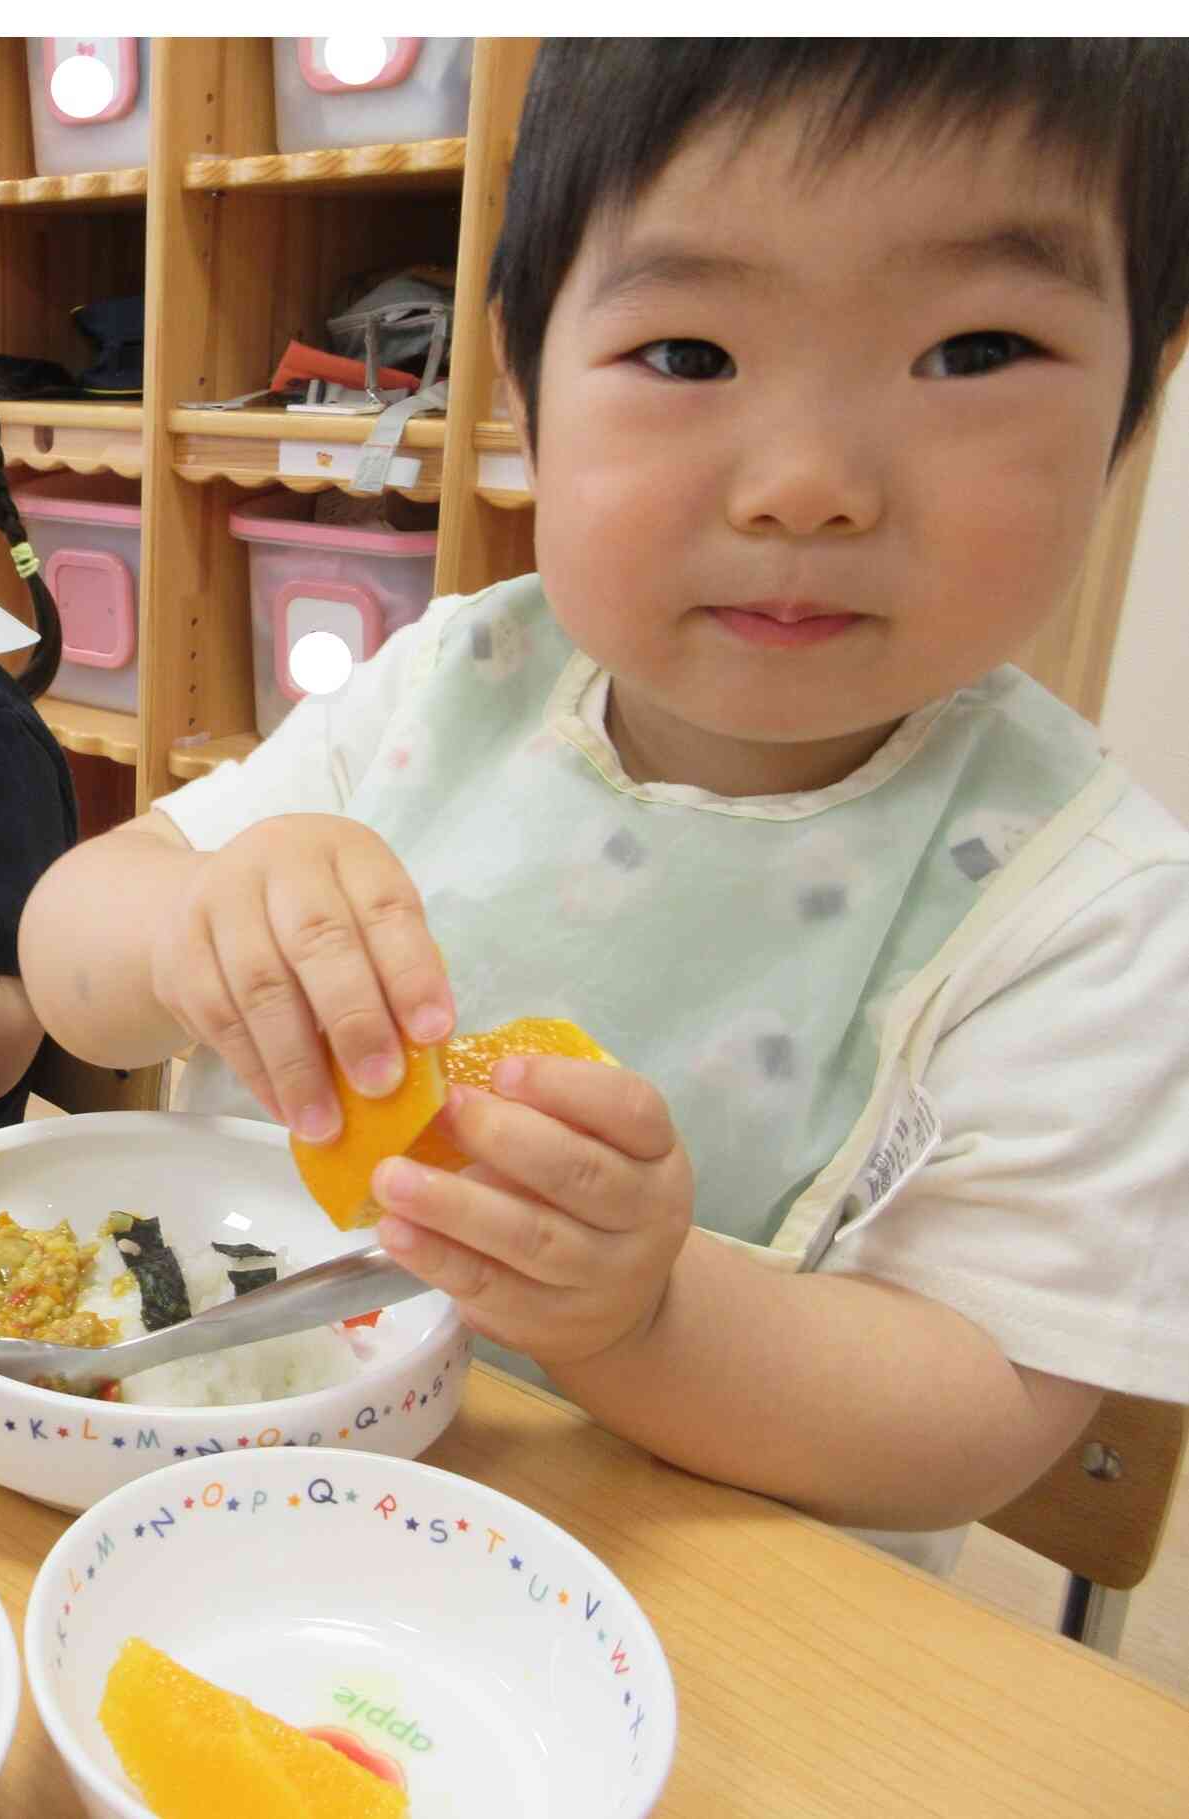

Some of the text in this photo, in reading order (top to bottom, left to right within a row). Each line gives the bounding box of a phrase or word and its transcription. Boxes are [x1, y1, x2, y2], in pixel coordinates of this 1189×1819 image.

[29, 1417, 49, 1440] K
[82, 1417, 100, 1440] L
[136, 1428, 161, 1449] M
[257, 1428, 281, 1447] O
[355, 1406, 379, 1430] Q
[402, 1389, 416, 1412] R
[96, 1532, 115, 1563] M
[148, 1507, 176, 1538] N
[201, 1482, 224, 1508] O
[252, 1490, 268, 1513] P
[308, 1478, 339, 1504] Q
[374, 1494, 397, 1520] R
[430, 1519, 449, 1544] S
[486, 1528, 506, 1554] T
[529, 1574, 548, 1601] U
[585, 1592, 602, 1621] V
[610, 1638, 630, 1675] W
[332, 1686, 434, 1752] apple
